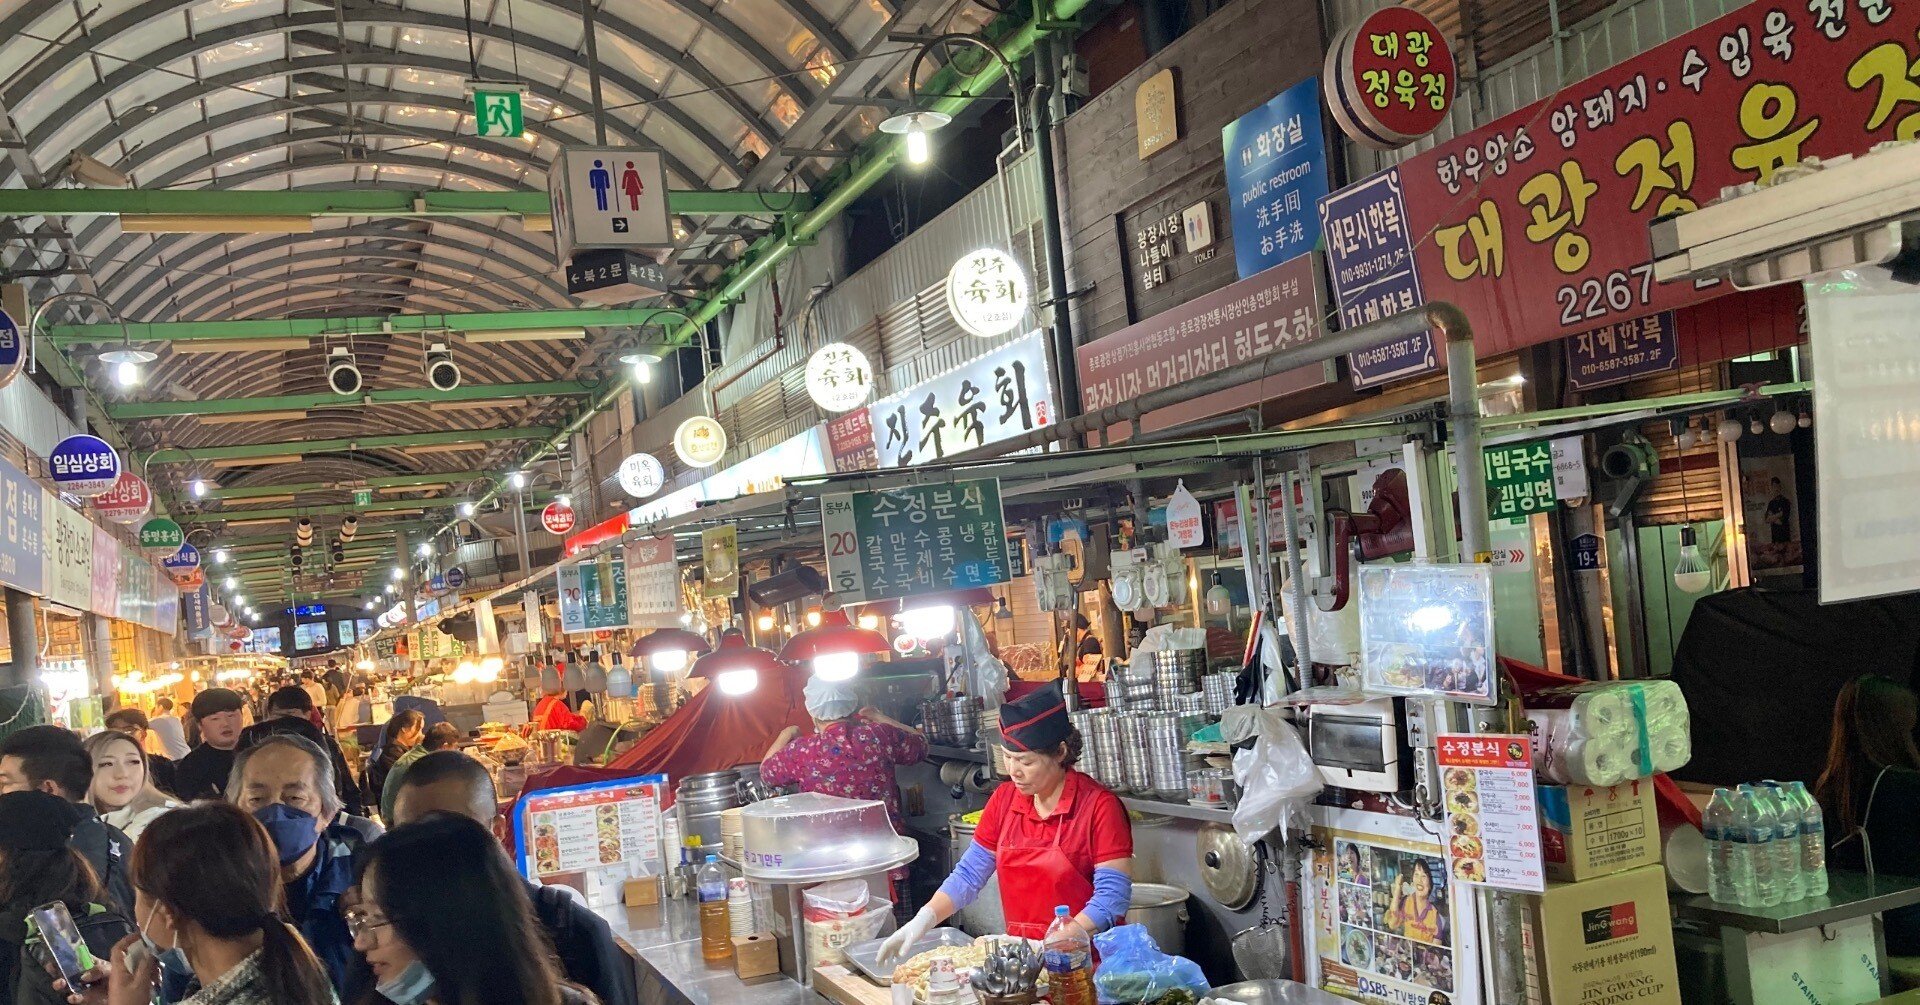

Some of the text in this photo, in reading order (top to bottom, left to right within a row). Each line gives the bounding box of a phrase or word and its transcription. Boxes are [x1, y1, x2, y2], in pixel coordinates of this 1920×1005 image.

[1370, 31, 1433, 68] 대광
[1683, 12, 1793, 92] 수입육
[1362, 69, 1446, 111] 정육점
[1256, 114, 1304, 158] 화장실
[1242, 160, 1312, 208] public restroom
[1137, 214, 1179, 248] 광장시장
[1260, 219, 1304, 256] お手洗
[1330, 197, 1401, 260] 세모시한복
[970, 256, 1006, 274] 진주
[1140, 239, 1171, 268] 나들이
[1194, 248, 1216, 264] TOILET
[964, 278, 1017, 304] 육회
[1143, 266, 1164, 291] 쉼터
[1281, 277, 1300, 300] 부설
[823, 350, 854, 364] 진주
[817, 366, 865, 389] 육회
[885, 359, 1034, 467] 진주육회
[53, 452, 114, 475] 일심상회
[67, 481, 106, 491] 2264-3845
[1493, 478, 1555, 516] 빔냉면
[104, 508, 140, 518] 2279-7014
[871, 486, 985, 527] 수정분식
[141, 529, 180, 543] 동명홍삼
[829, 531, 858, 557] 20
[980, 520, 1003, 580] 칼만두국
[866, 535, 890, 595] 칼국수
[890, 532, 914, 591] 만두국
[913, 529, 935, 588] 수제비
[935, 526, 959, 586] 콩국수
[836, 569, 861, 594] 호
[1442, 741, 1500, 757] 수정분식
[1586, 916, 1635, 933] JinGwang
[1582, 988, 1603, 1001] JIN
[1606, 974, 1655, 994] GWANG
[1638, 983, 1665, 998] CUP
